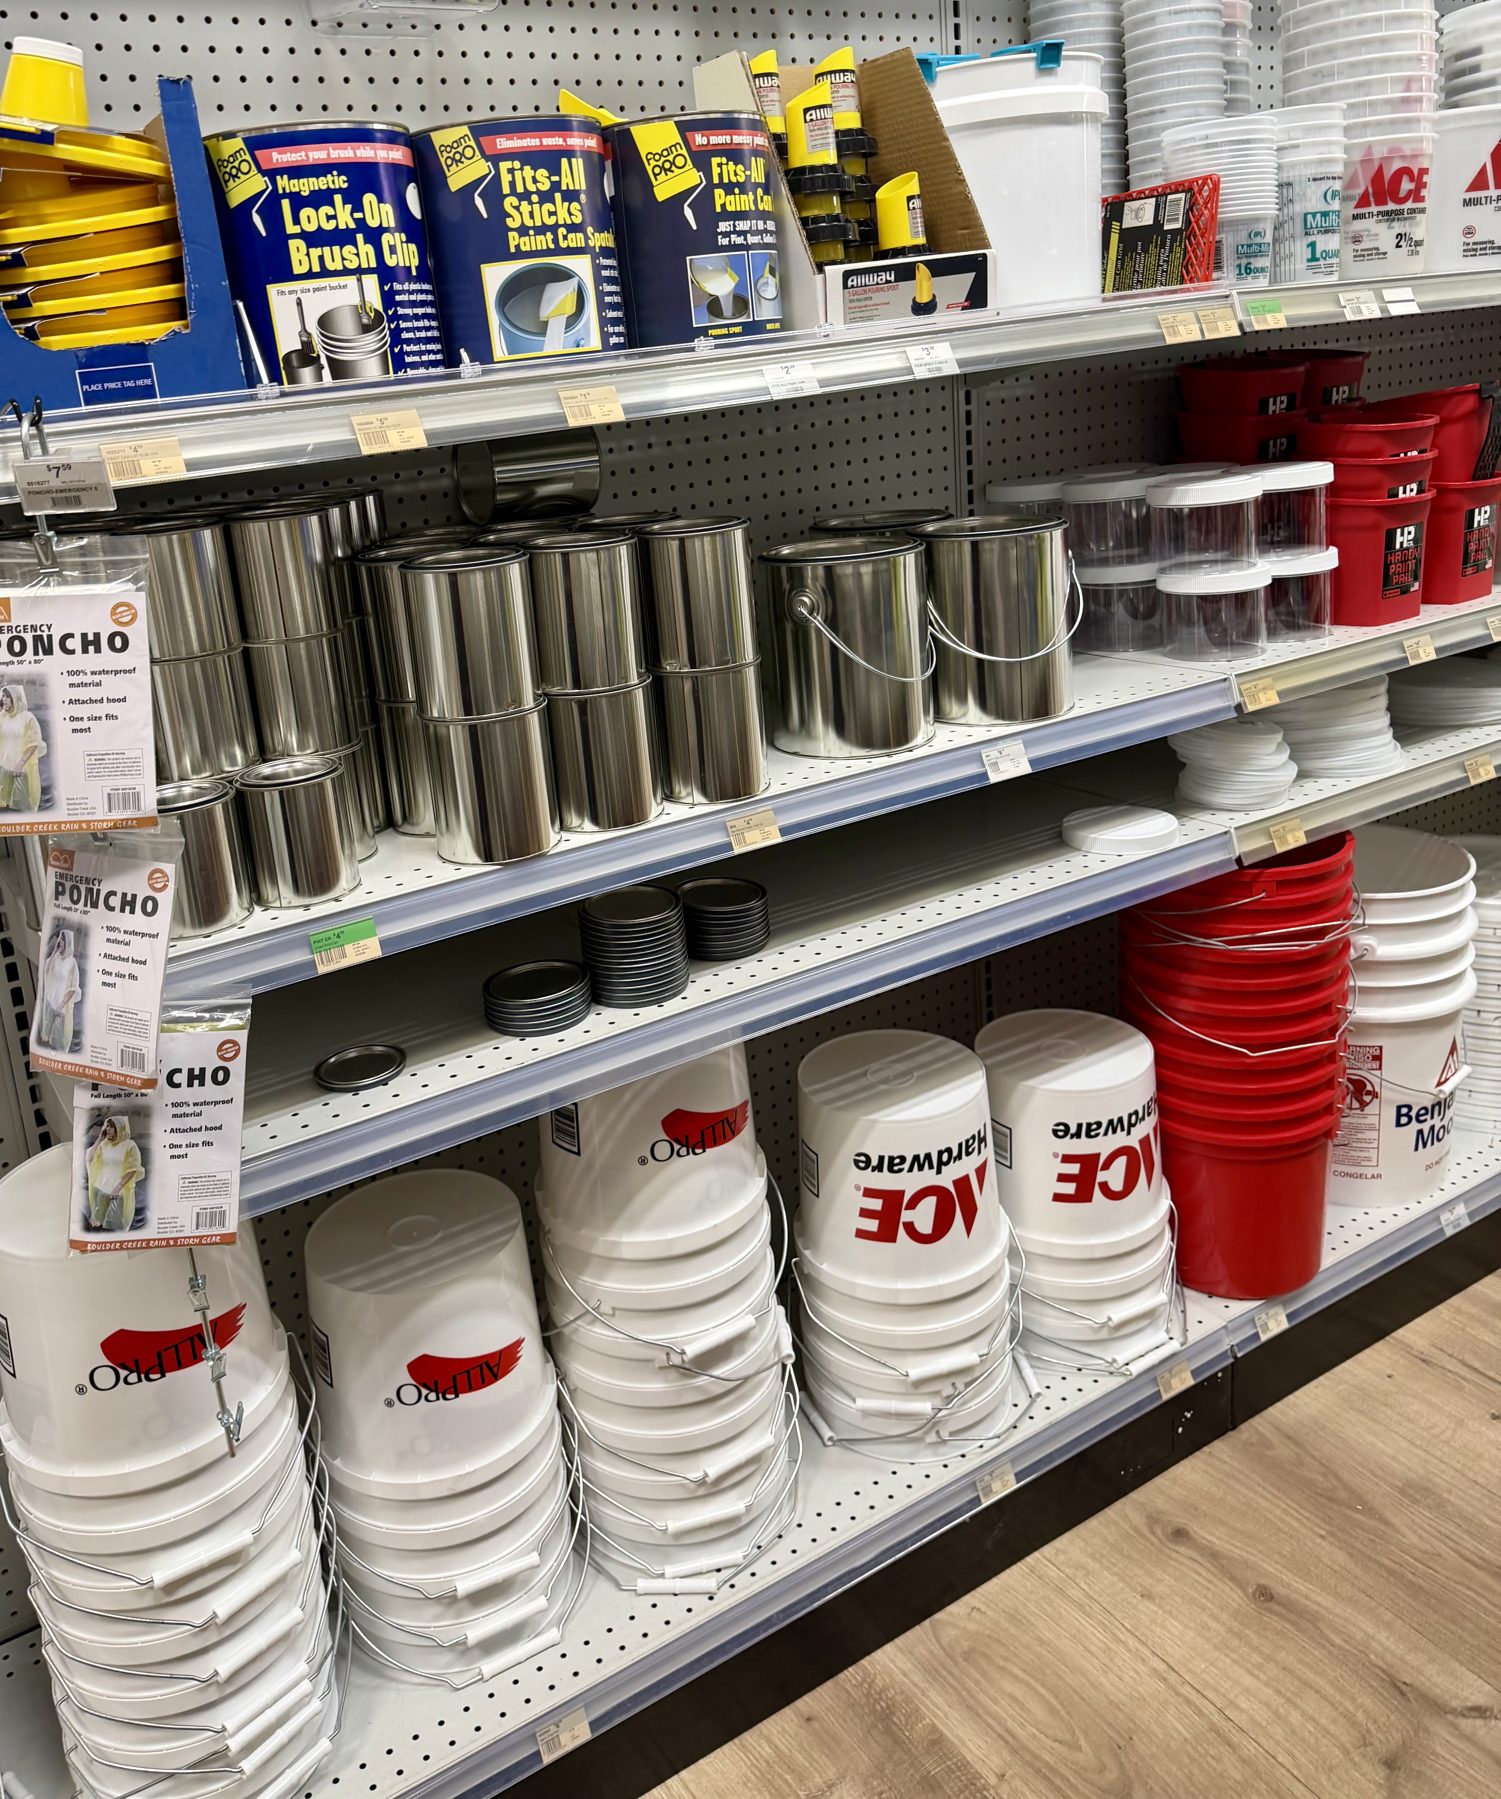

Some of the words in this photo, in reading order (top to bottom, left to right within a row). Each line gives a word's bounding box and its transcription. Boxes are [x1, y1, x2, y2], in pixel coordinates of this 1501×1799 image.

[496, 137, 540, 149] Eliminates
[542, 136, 566, 147] waste,
[695, 134, 707, 145] No
[709, 134, 731, 145] more
[733, 134, 753, 147] messy
[272, 151, 306, 163] Protect
[308, 150, 329, 162] your
[329, 147, 355, 158] brush
[355, 146, 375, 158] while
[376, 149, 388, 161] you
[444, 144, 477, 173] PRO
[223, 159, 252, 188] PRO
[651, 153, 688, 181] PRO
[711, 156, 765, 184] Fits-All
[499, 157, 586, 195] Fits-All
[276, 171, 348, 196] Magnetic
[1354, 163, 1429, 208] ACE
[714, 187, 755, 213] Paint
[756, 187, 773, 212] Can
[281, 193, 395, 235] Lock-On
[1352, 208, 1405, 221] MULTI-PURPOSE
[717, 221, 734, 232] JUST
[735, 220, 751, 231] SNAP
[508, 230, 555, 253] Paint
[557, 227, 586, 248] Can
[718, 235, 730, 246] For
[731, 234, 746, 245] Pint,
[288, 237, 376, 275] Brush
[381, 232, 419, 276] Clip
[1306, 240, 1320, 263] 1
[1236, 262, 1252, 276] 16
[848, 271, 895, 288] Allway
[276, 288, 288, 297] Fits
[288, 288, 300, 298] any
[299, 286, 312, 295] size
[312, 284, 327, 295] paint
[328, 283, 348, 293] bucket
[851, 287, 867, 297] GALLON
[867, 285, 887, 296] POURING
[886, 284, 900, 293] SPOUT
[83, 382, 102, 392] PLACE
[103, 380, 122, 390] PRICE
[123, 378, 135, 388] TAG
[136, 376, 153, 387] HERE
[1396, 525, 1416, 550] HP
[1468, 538, 1490, 553] PAINT
[1388, 546, 1420, 564] HANDY
[1390, 560, 1416, 575] PAINT
[1393, 573, 1413, 586] PAIL
[0, 623, 53, 635] ERGENCY
[0, 631, 130, 658] ONCHO
[66, 669, 88, 677] 100%
[90, 667, 136, 677] waterproof
[68, 680, 102, 689] material
[68, 697, 104, 706] Attached
[106, 696, 127, 705] hood
[69, 715, 84, 723] One
[87, 714, 102, 722] size
[105, 713, 119, 721] fits
[72, 726, 91, 734] most
[33, 823, 58, 832] CREEK
[61, 822, 79, 831] RAIN
[90, 820, 114, 830] STORM
[117, 819, 138, 828] GEAR
[55, 870, 103, 887] EMERGENCY
[54, 881, 159, 918] PONCHO
[105, 925, 122, 934] 100%
[123, 927, 159, 940] waterproof
[106, 937, 131, 947] material
[103, 952, 130, 964] Attached
[131, 955, 147, 966] hood
[101, 969, 113, 977] One
[114, 970, 127, 979] size
[128, 972, 139, 982] fits
[101, 981, 117, 989] most
[1349, 1046, 1380, 1055] RNING
[38, 1057, 62, 1071] BOULDER
[63, 1062, 84, 1075] CREEK
[85, 1067, 99, 1077] RAIN
[106, 1072, 125, 1082] STORM
[126, 1076, 142, 1087] GEAR
[102, 1092, 122, 1100] Length
[171, 1100, 190, 1109] 100%
[192, 1097, 233, 1108] waterproof
[172, 1110, 202, 1119] material
[169, 1125, 202, 1134] Attached
[204, 1124, 223, 1132] hood
[185, 1141, 199, 1149] size
[201, 1140, 214, 1148] fits
[853, 1120, 989, 1175] Hardware
[170, 1152, 188, 1160] most
[1332, 1170, 1382, 1181] CONGELAR
[87, 1240, 121, 1250] BOULDER
[123, 1239, 148, 1249] CREEK
[150, 1238, 167, 1247] RAIN
[177, 1237, 200, 1246] STORM
[202, 1235, 221, 1244] GEAR
